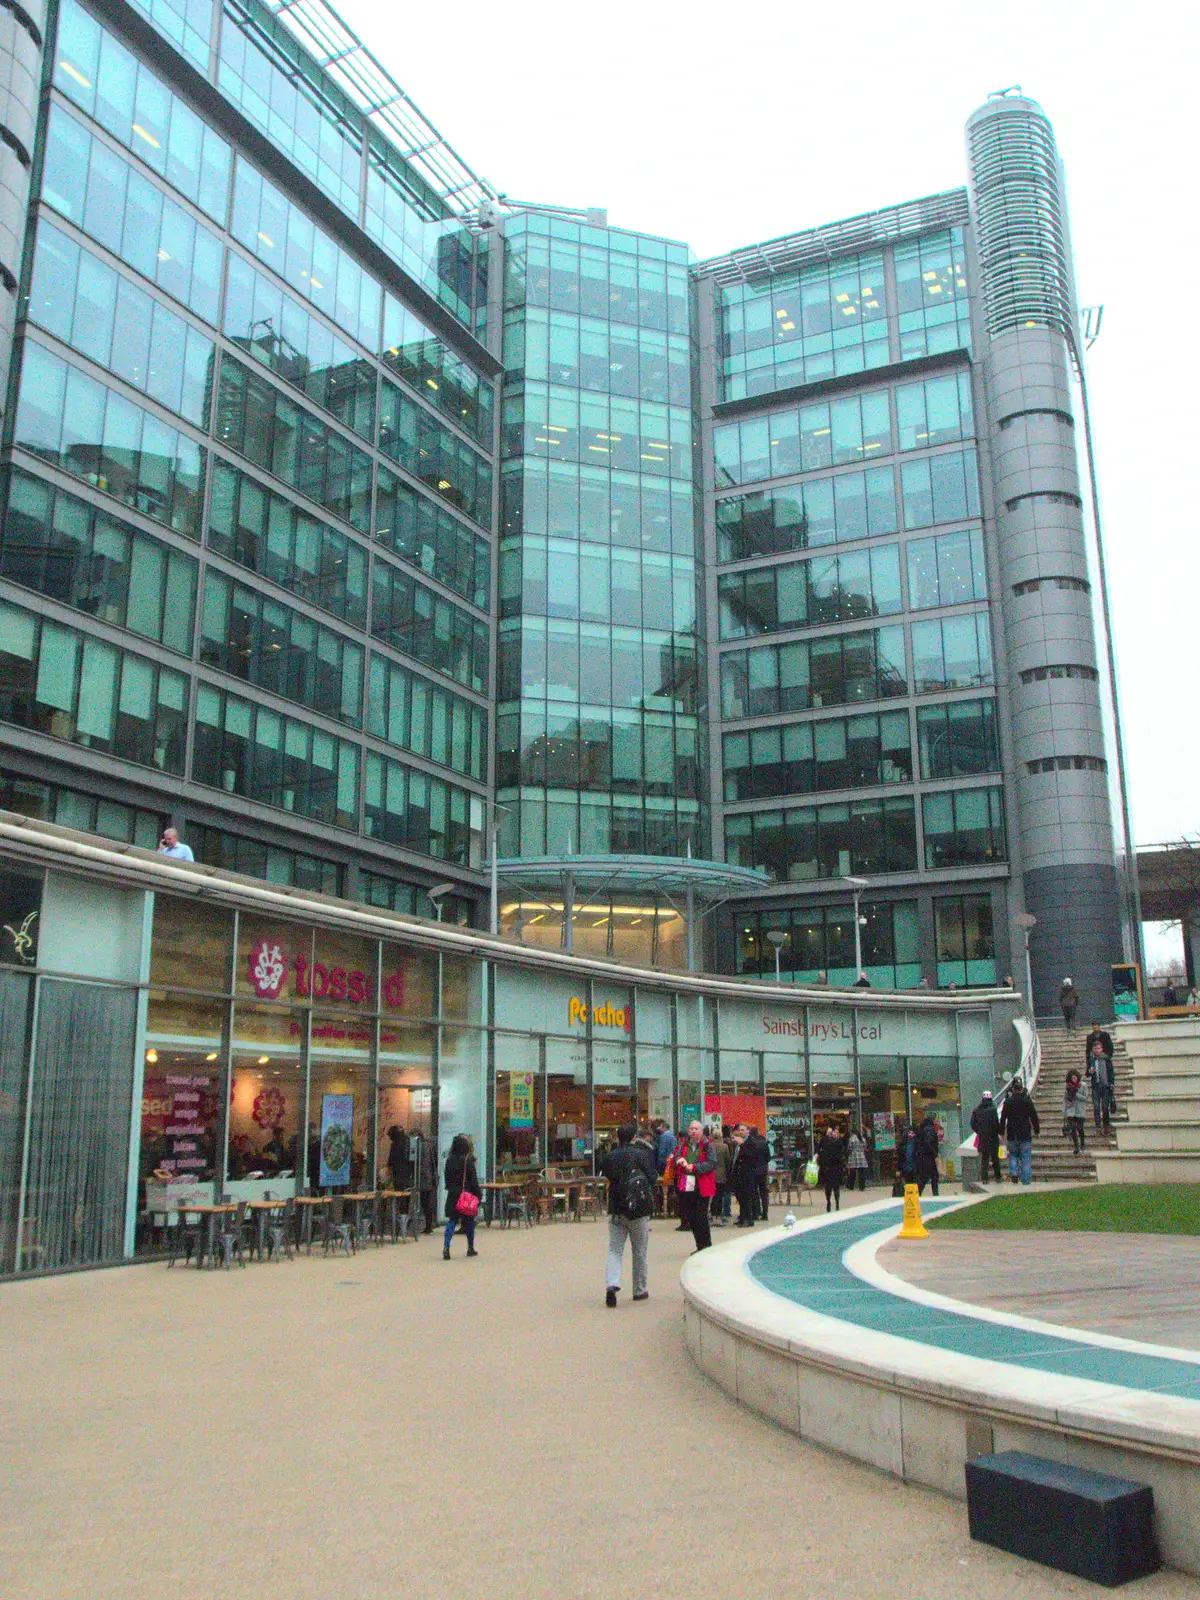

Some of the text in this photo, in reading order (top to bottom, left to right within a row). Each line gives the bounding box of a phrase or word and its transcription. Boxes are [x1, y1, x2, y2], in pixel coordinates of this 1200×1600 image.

[763, 1017, 881, 1040] Sainsbury's Lcal
[768, 1115, 811, 1128] Sainsbury's
